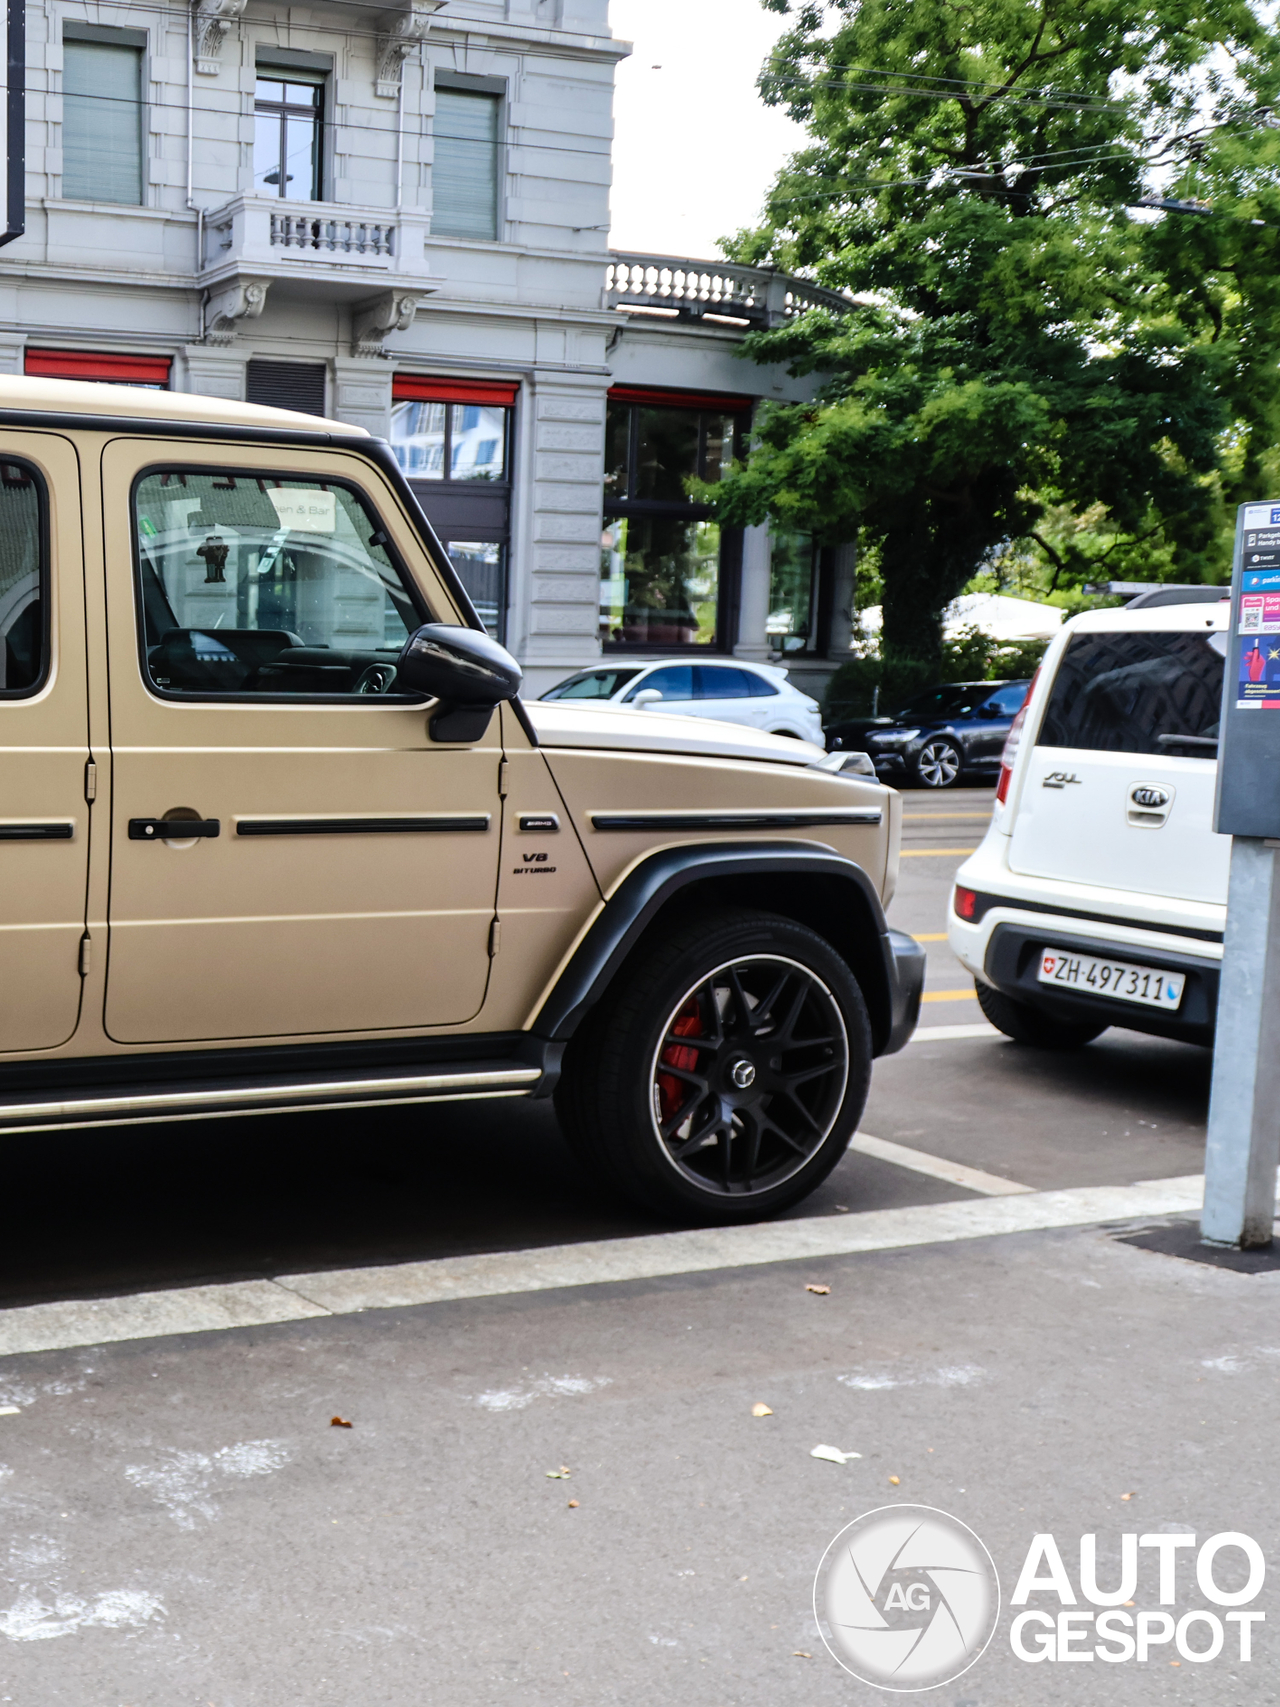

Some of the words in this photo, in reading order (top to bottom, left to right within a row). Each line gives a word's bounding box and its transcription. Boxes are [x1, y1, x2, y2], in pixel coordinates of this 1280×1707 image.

[309, 505, 330, 515] Bar
[1044, 771, 1082, 784] SOUL
[1135, 790, 1161, 804] KIA
[522, 852, 548, 862] V8
